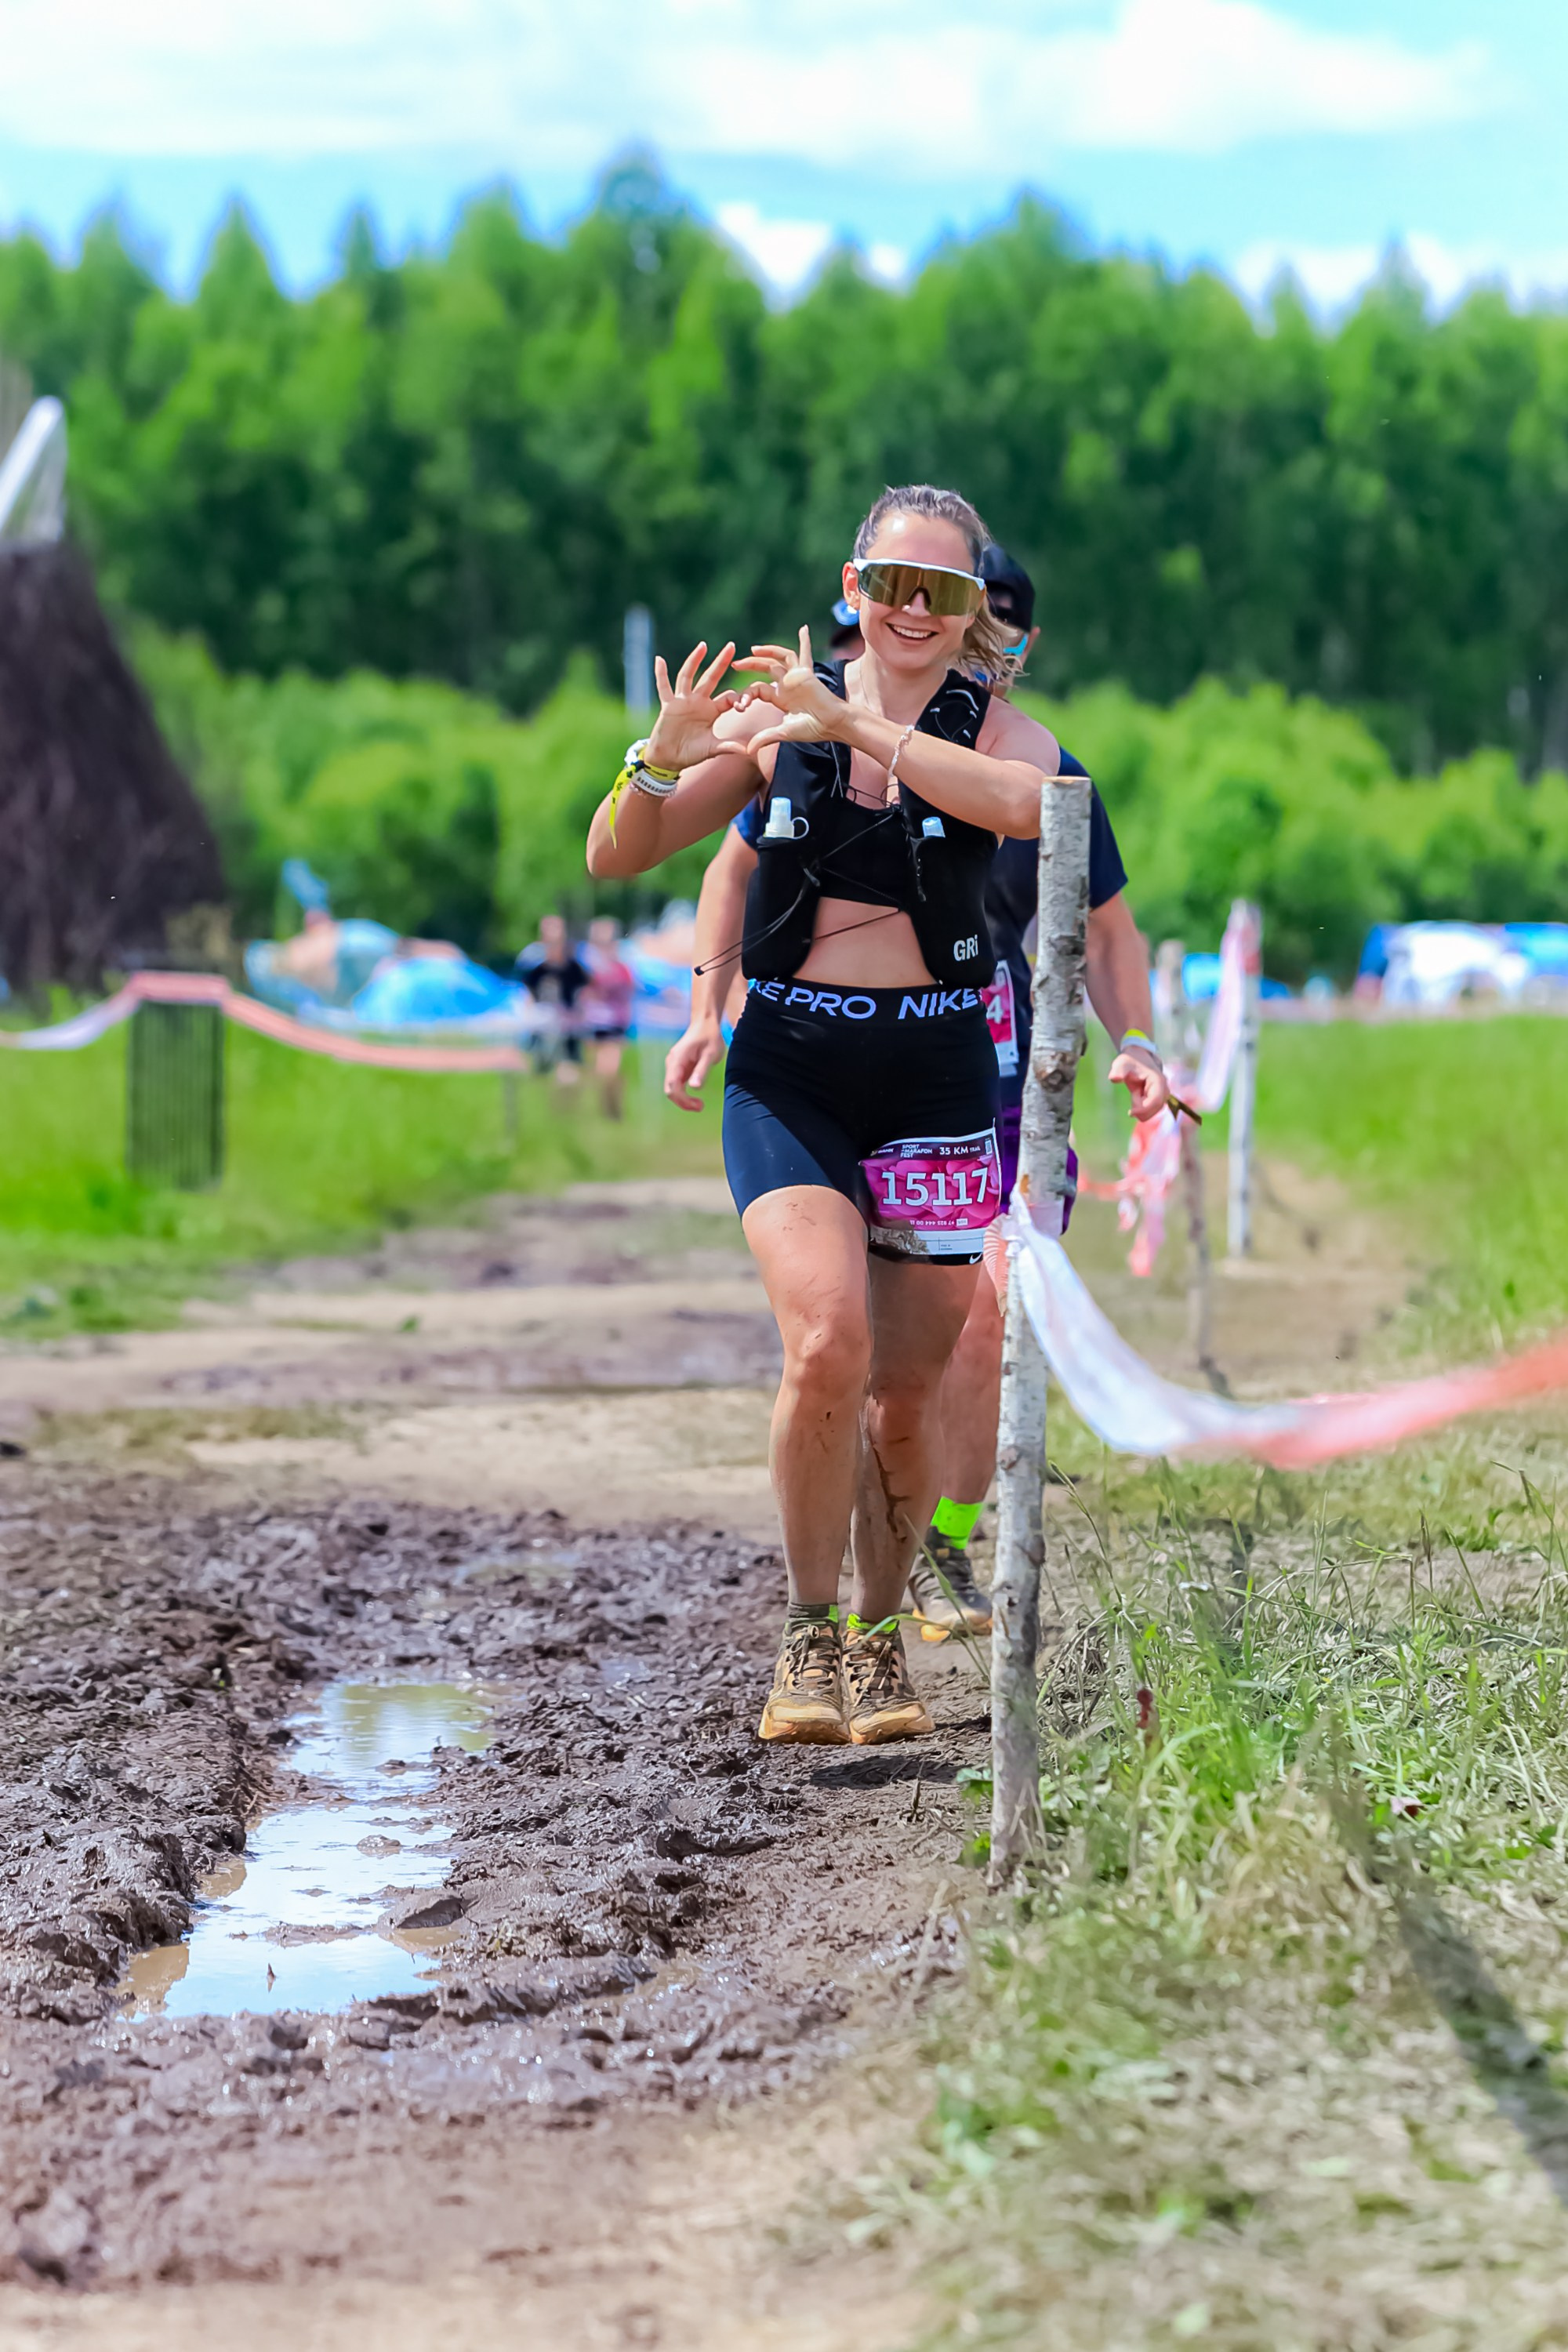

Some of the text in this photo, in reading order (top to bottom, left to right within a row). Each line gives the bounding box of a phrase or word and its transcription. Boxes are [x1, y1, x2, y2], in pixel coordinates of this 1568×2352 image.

[785, 986, 877, 1019] PRO
[898, 988, 978, 1019] NIKE
[939, 1146, 951, 1156] 35
[953, 1145, 968, 1156] KM
[881, 1167, 988, 1207] 15117
